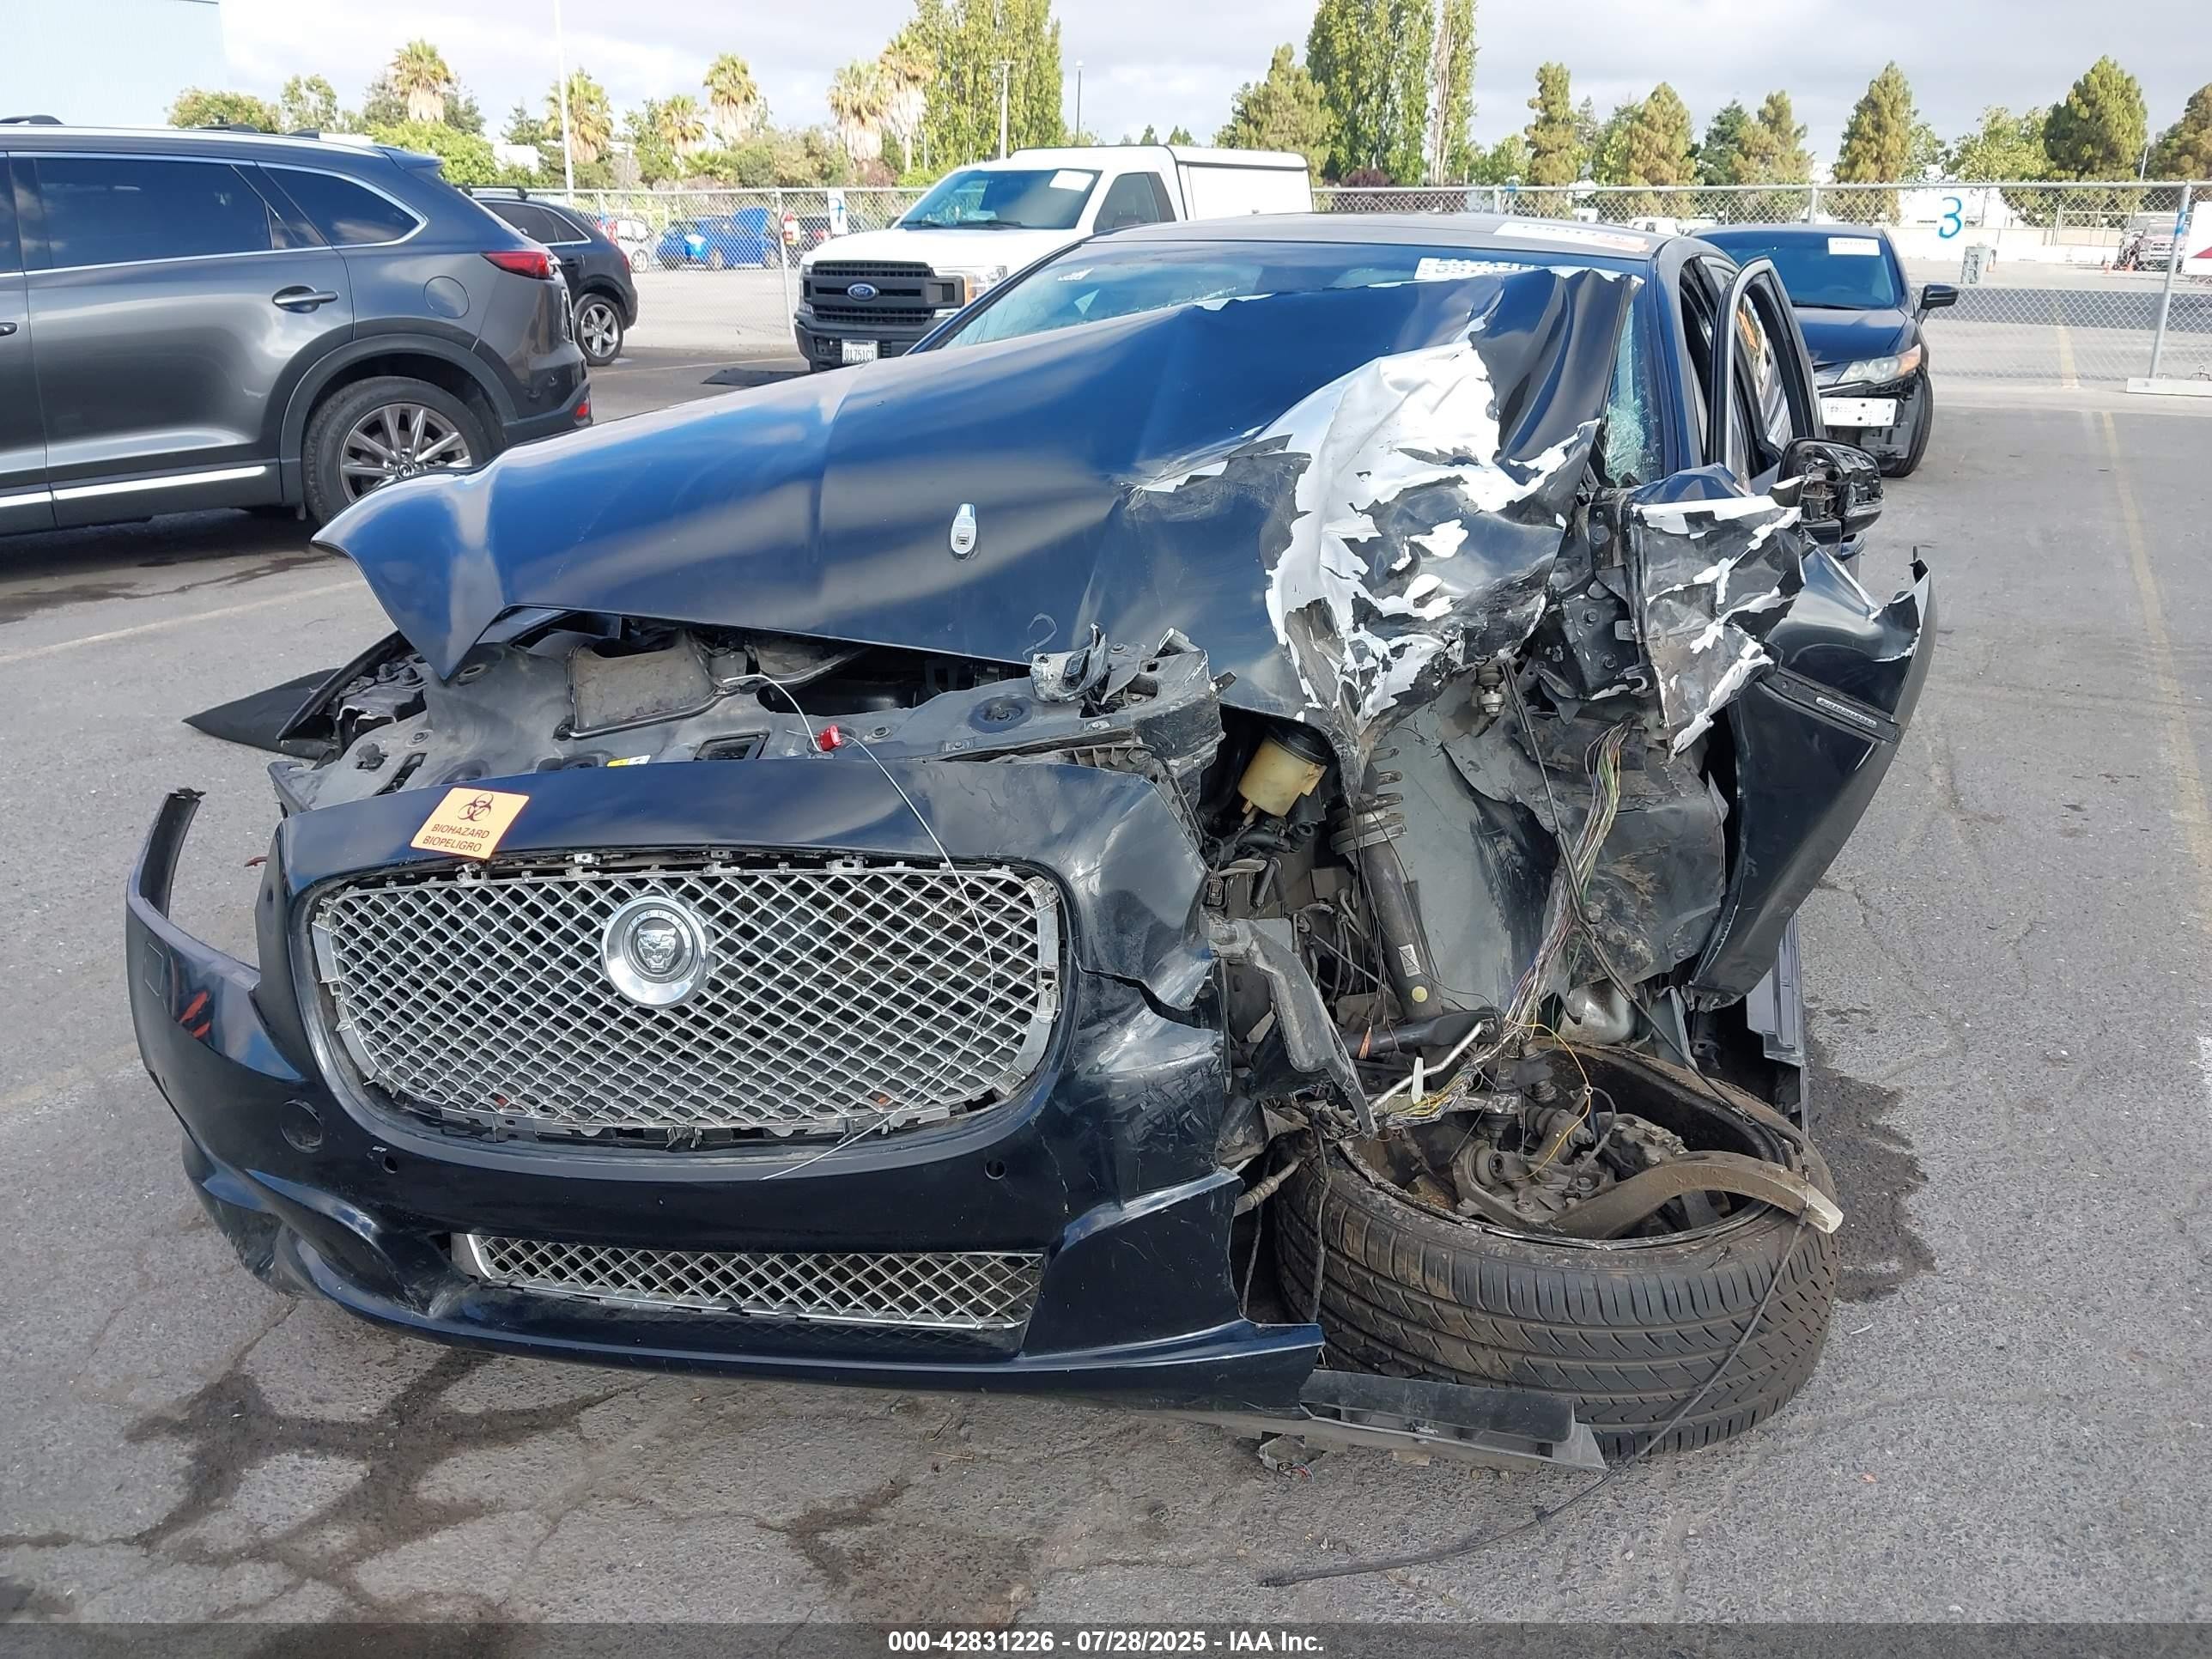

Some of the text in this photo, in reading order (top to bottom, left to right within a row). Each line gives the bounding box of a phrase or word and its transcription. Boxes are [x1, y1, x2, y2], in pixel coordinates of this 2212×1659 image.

[1939, 196, 1962, 239] 3
[431, 823, 490, 839] BIOHAZARD
[422, 836, 483, 853] BIOPELIGRO
[629, 910, 684, 929] JAGUAR
